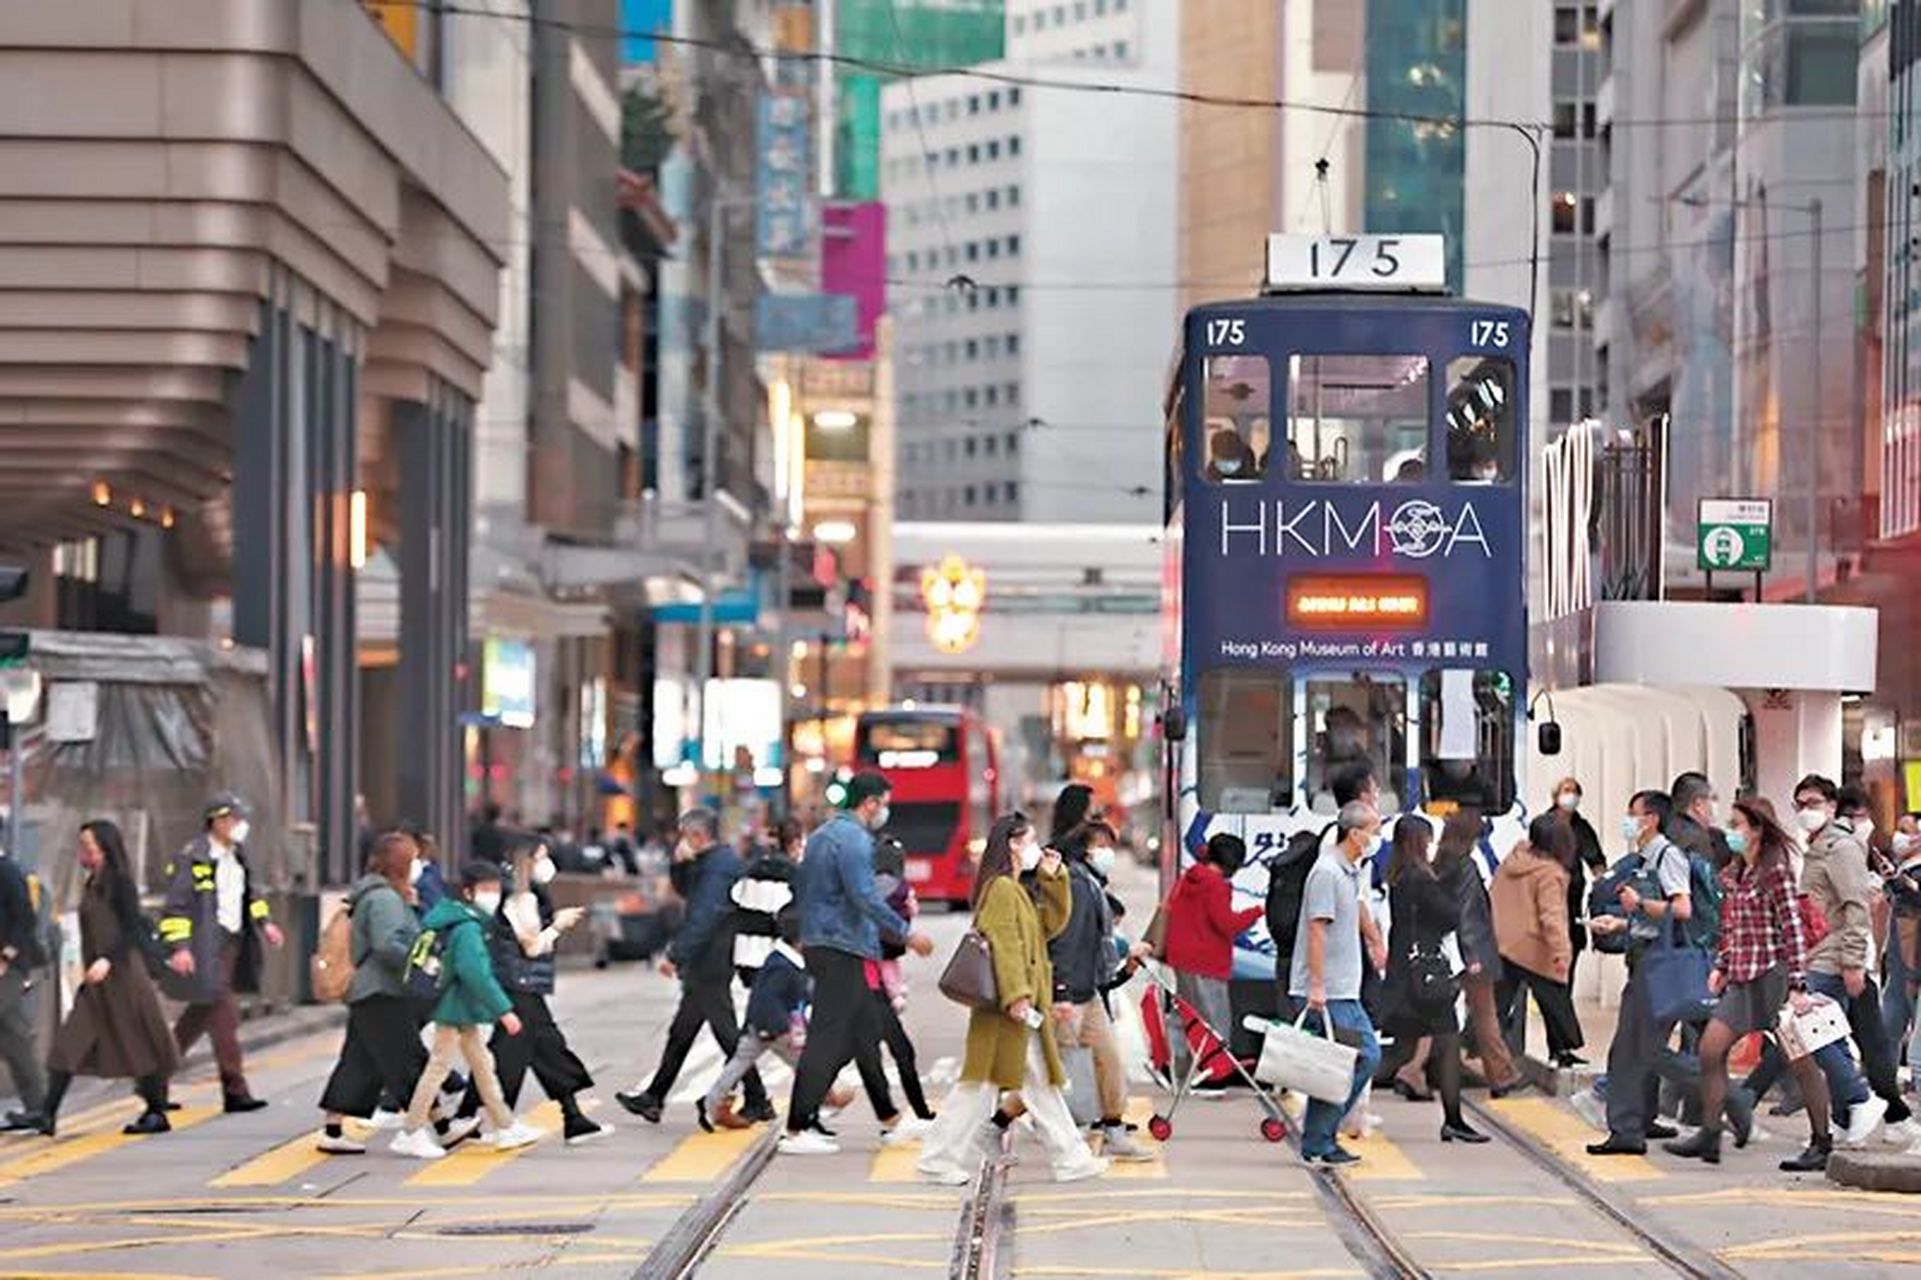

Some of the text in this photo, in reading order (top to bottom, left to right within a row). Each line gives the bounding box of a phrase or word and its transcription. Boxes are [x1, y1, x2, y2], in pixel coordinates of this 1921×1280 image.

[1311, 239, 1400, 277] 175
[1207, 319, 1245, 346] 175
[1471, 320, 1509, 348] 175
[1221, 640, 1405, 659] Hong Kong Museum of Art
